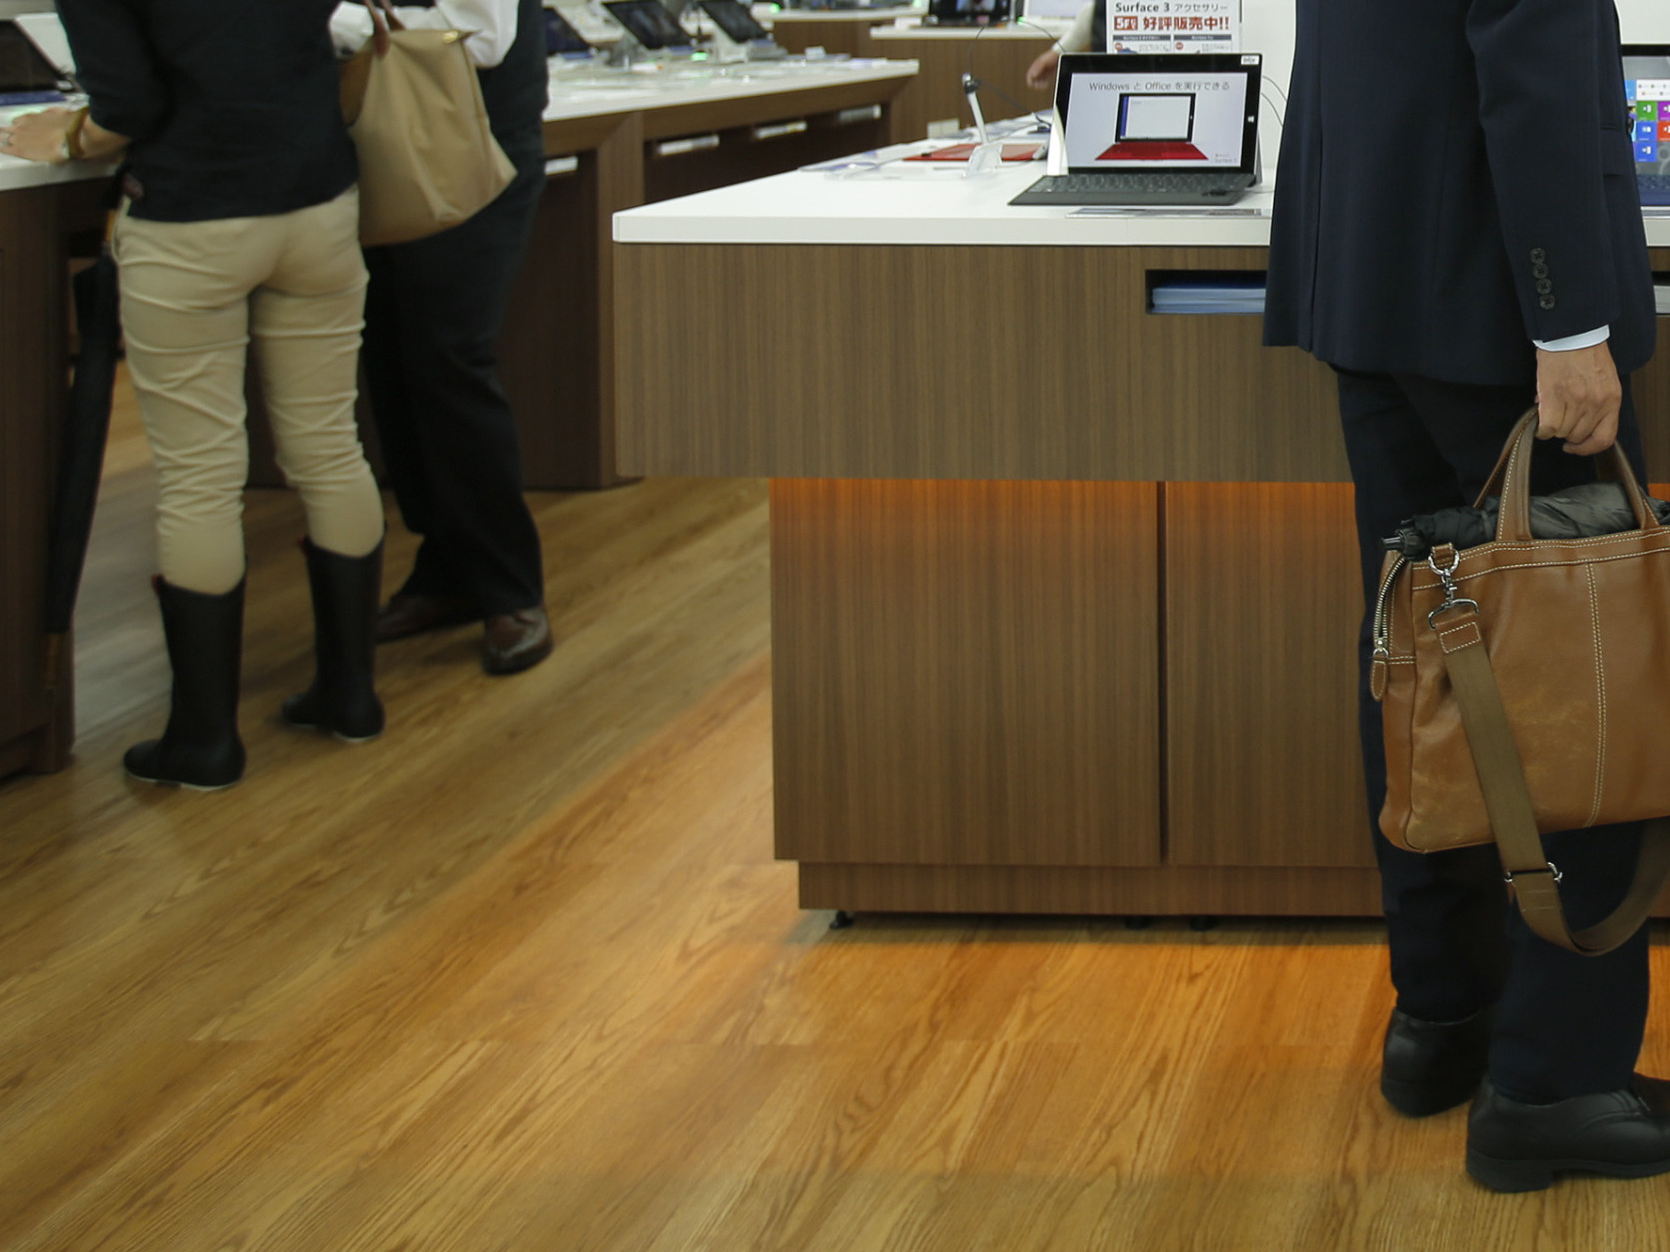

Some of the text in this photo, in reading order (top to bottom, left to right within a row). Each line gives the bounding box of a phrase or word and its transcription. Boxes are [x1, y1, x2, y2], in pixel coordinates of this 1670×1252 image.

[1115, 2, 1229, 12] Surface 3 アクセサリー
[1143, 16, 1229, 31] 好評販売中!!
[1089, 81, 1130, 91] Windows
[1145, 81, 1171, 91] Office
[1175, 81, 1230, 91] を実行できる
